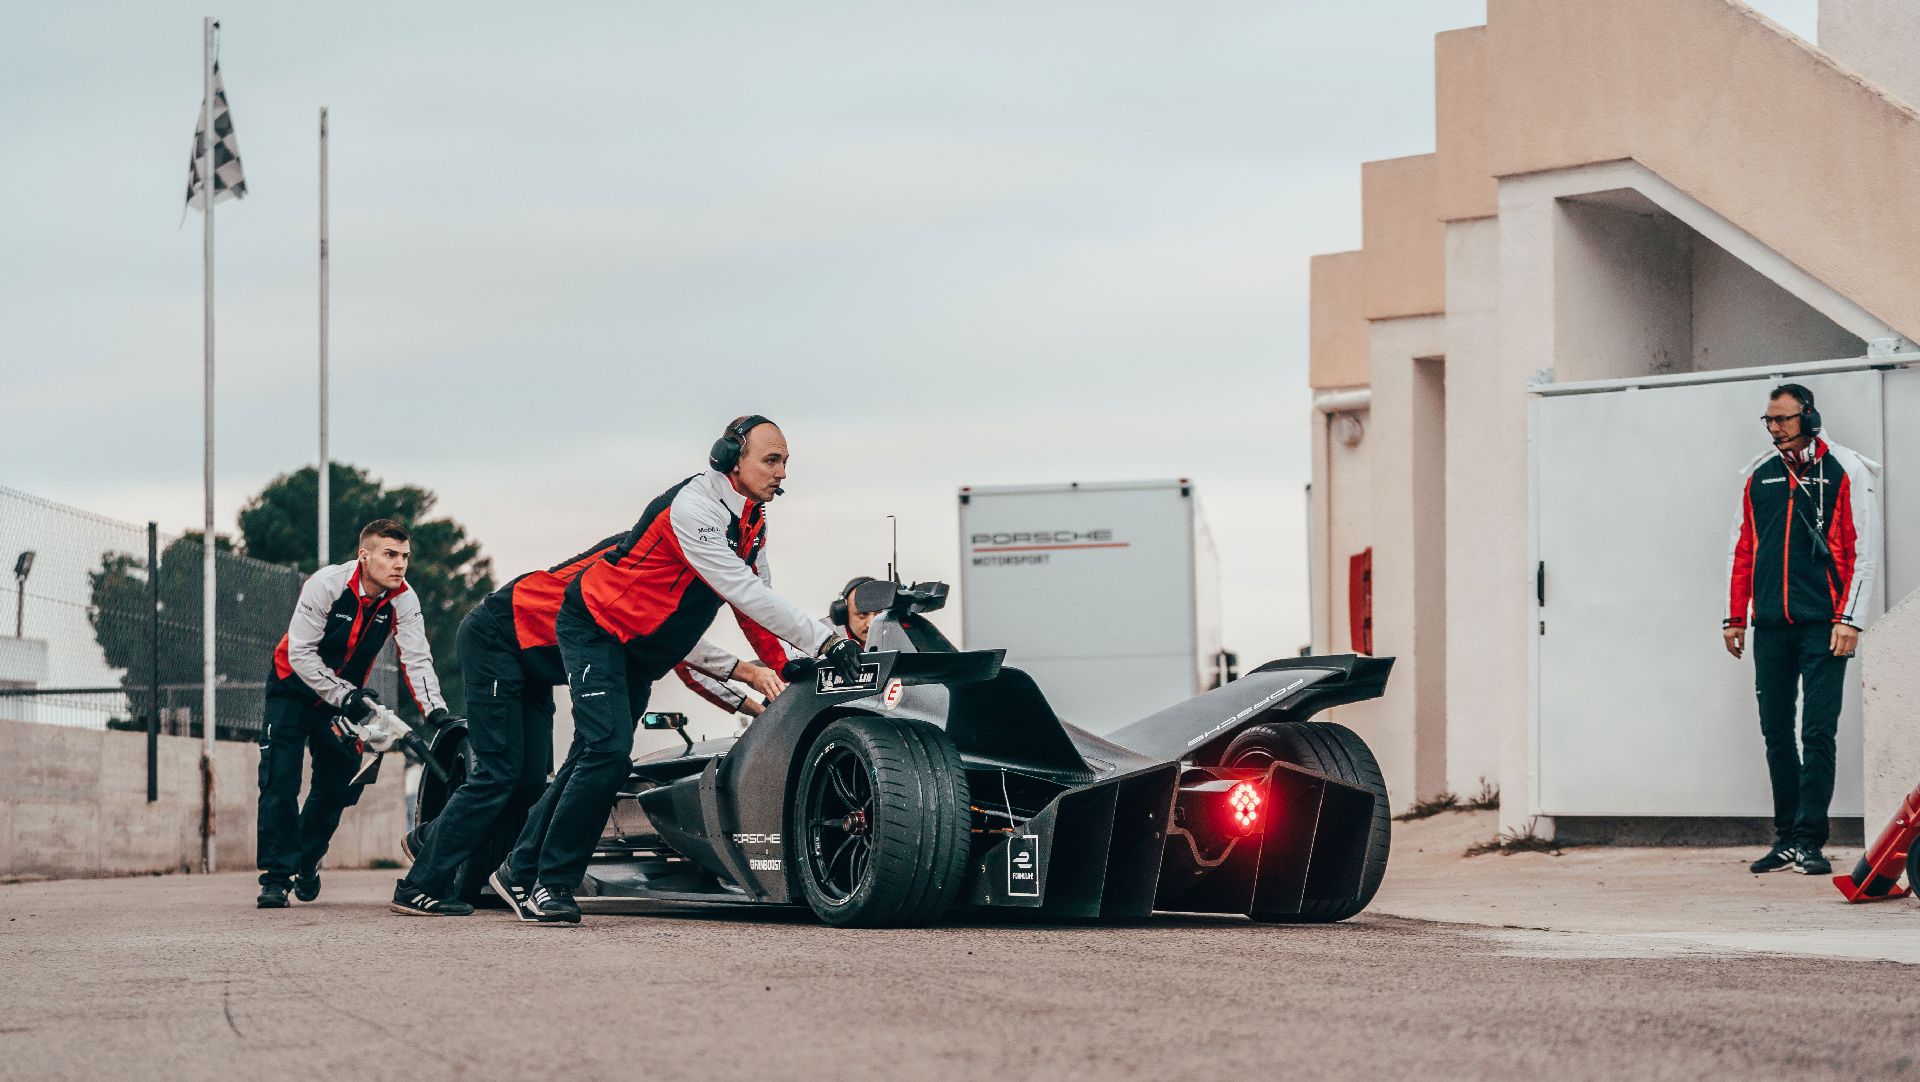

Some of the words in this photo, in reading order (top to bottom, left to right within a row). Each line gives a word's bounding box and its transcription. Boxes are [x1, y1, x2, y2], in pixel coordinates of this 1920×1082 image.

[972, 529, 1112, 544] PORSCHE
[973, 555, 1050, 566] MOTORSPORT
[888, 684, 900, 700] E
[1188, 679, 1303, 746] PORSCHE
[733, 834, 780, 843] PORSCHE
